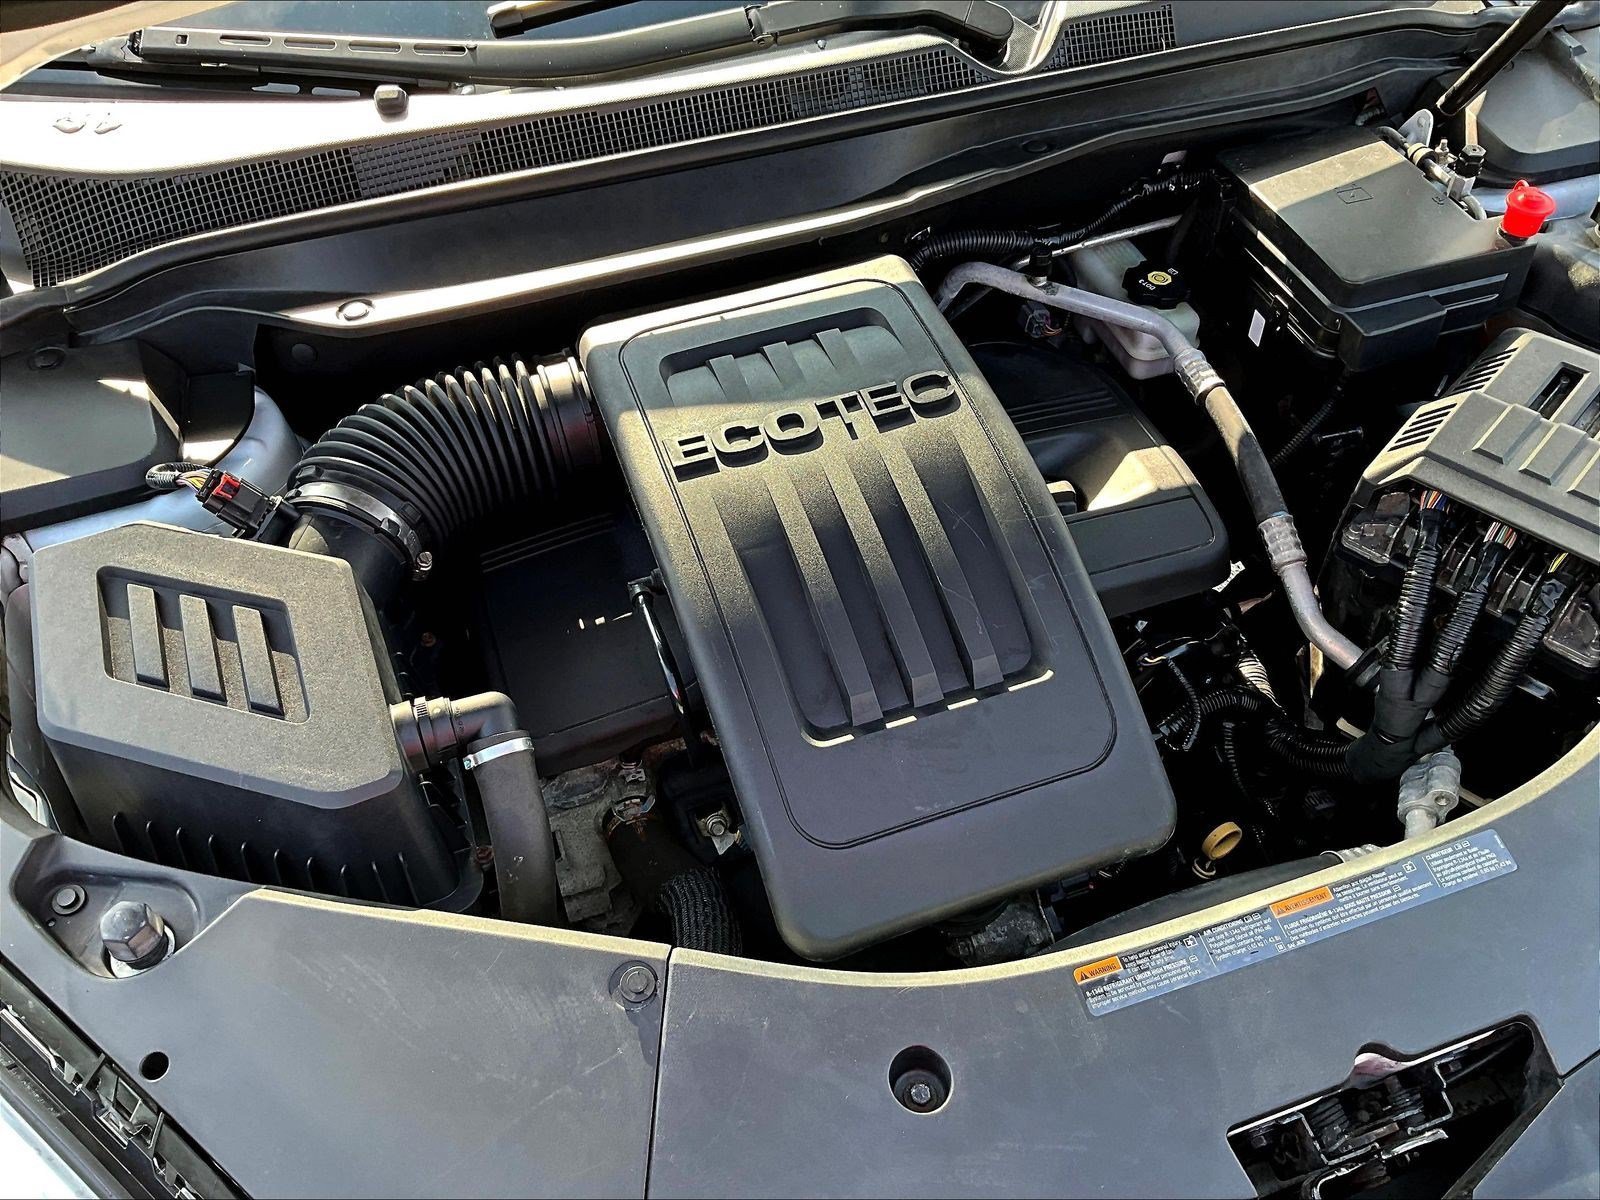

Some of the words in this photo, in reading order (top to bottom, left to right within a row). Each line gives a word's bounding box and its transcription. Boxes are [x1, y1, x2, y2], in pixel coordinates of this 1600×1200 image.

[662, 370, 959, 478] ECOTEC
[1283, 891, 1327, 911] AVERTISSEMENT
[1127, 953, 1139, 961] help
[1137, 949, 1151, 958] avoid
[1149, 943, 1169, 954] personal
[1088, 963, 1117, 977] WARNING
[1102, 975, 1135, 992] REFRIGERANT
[1134, 970, 1152, 981] UNDER
[1150, 966, 1163, 975] HIGH
[1162, 958, 1187, 971] PRESSURE
